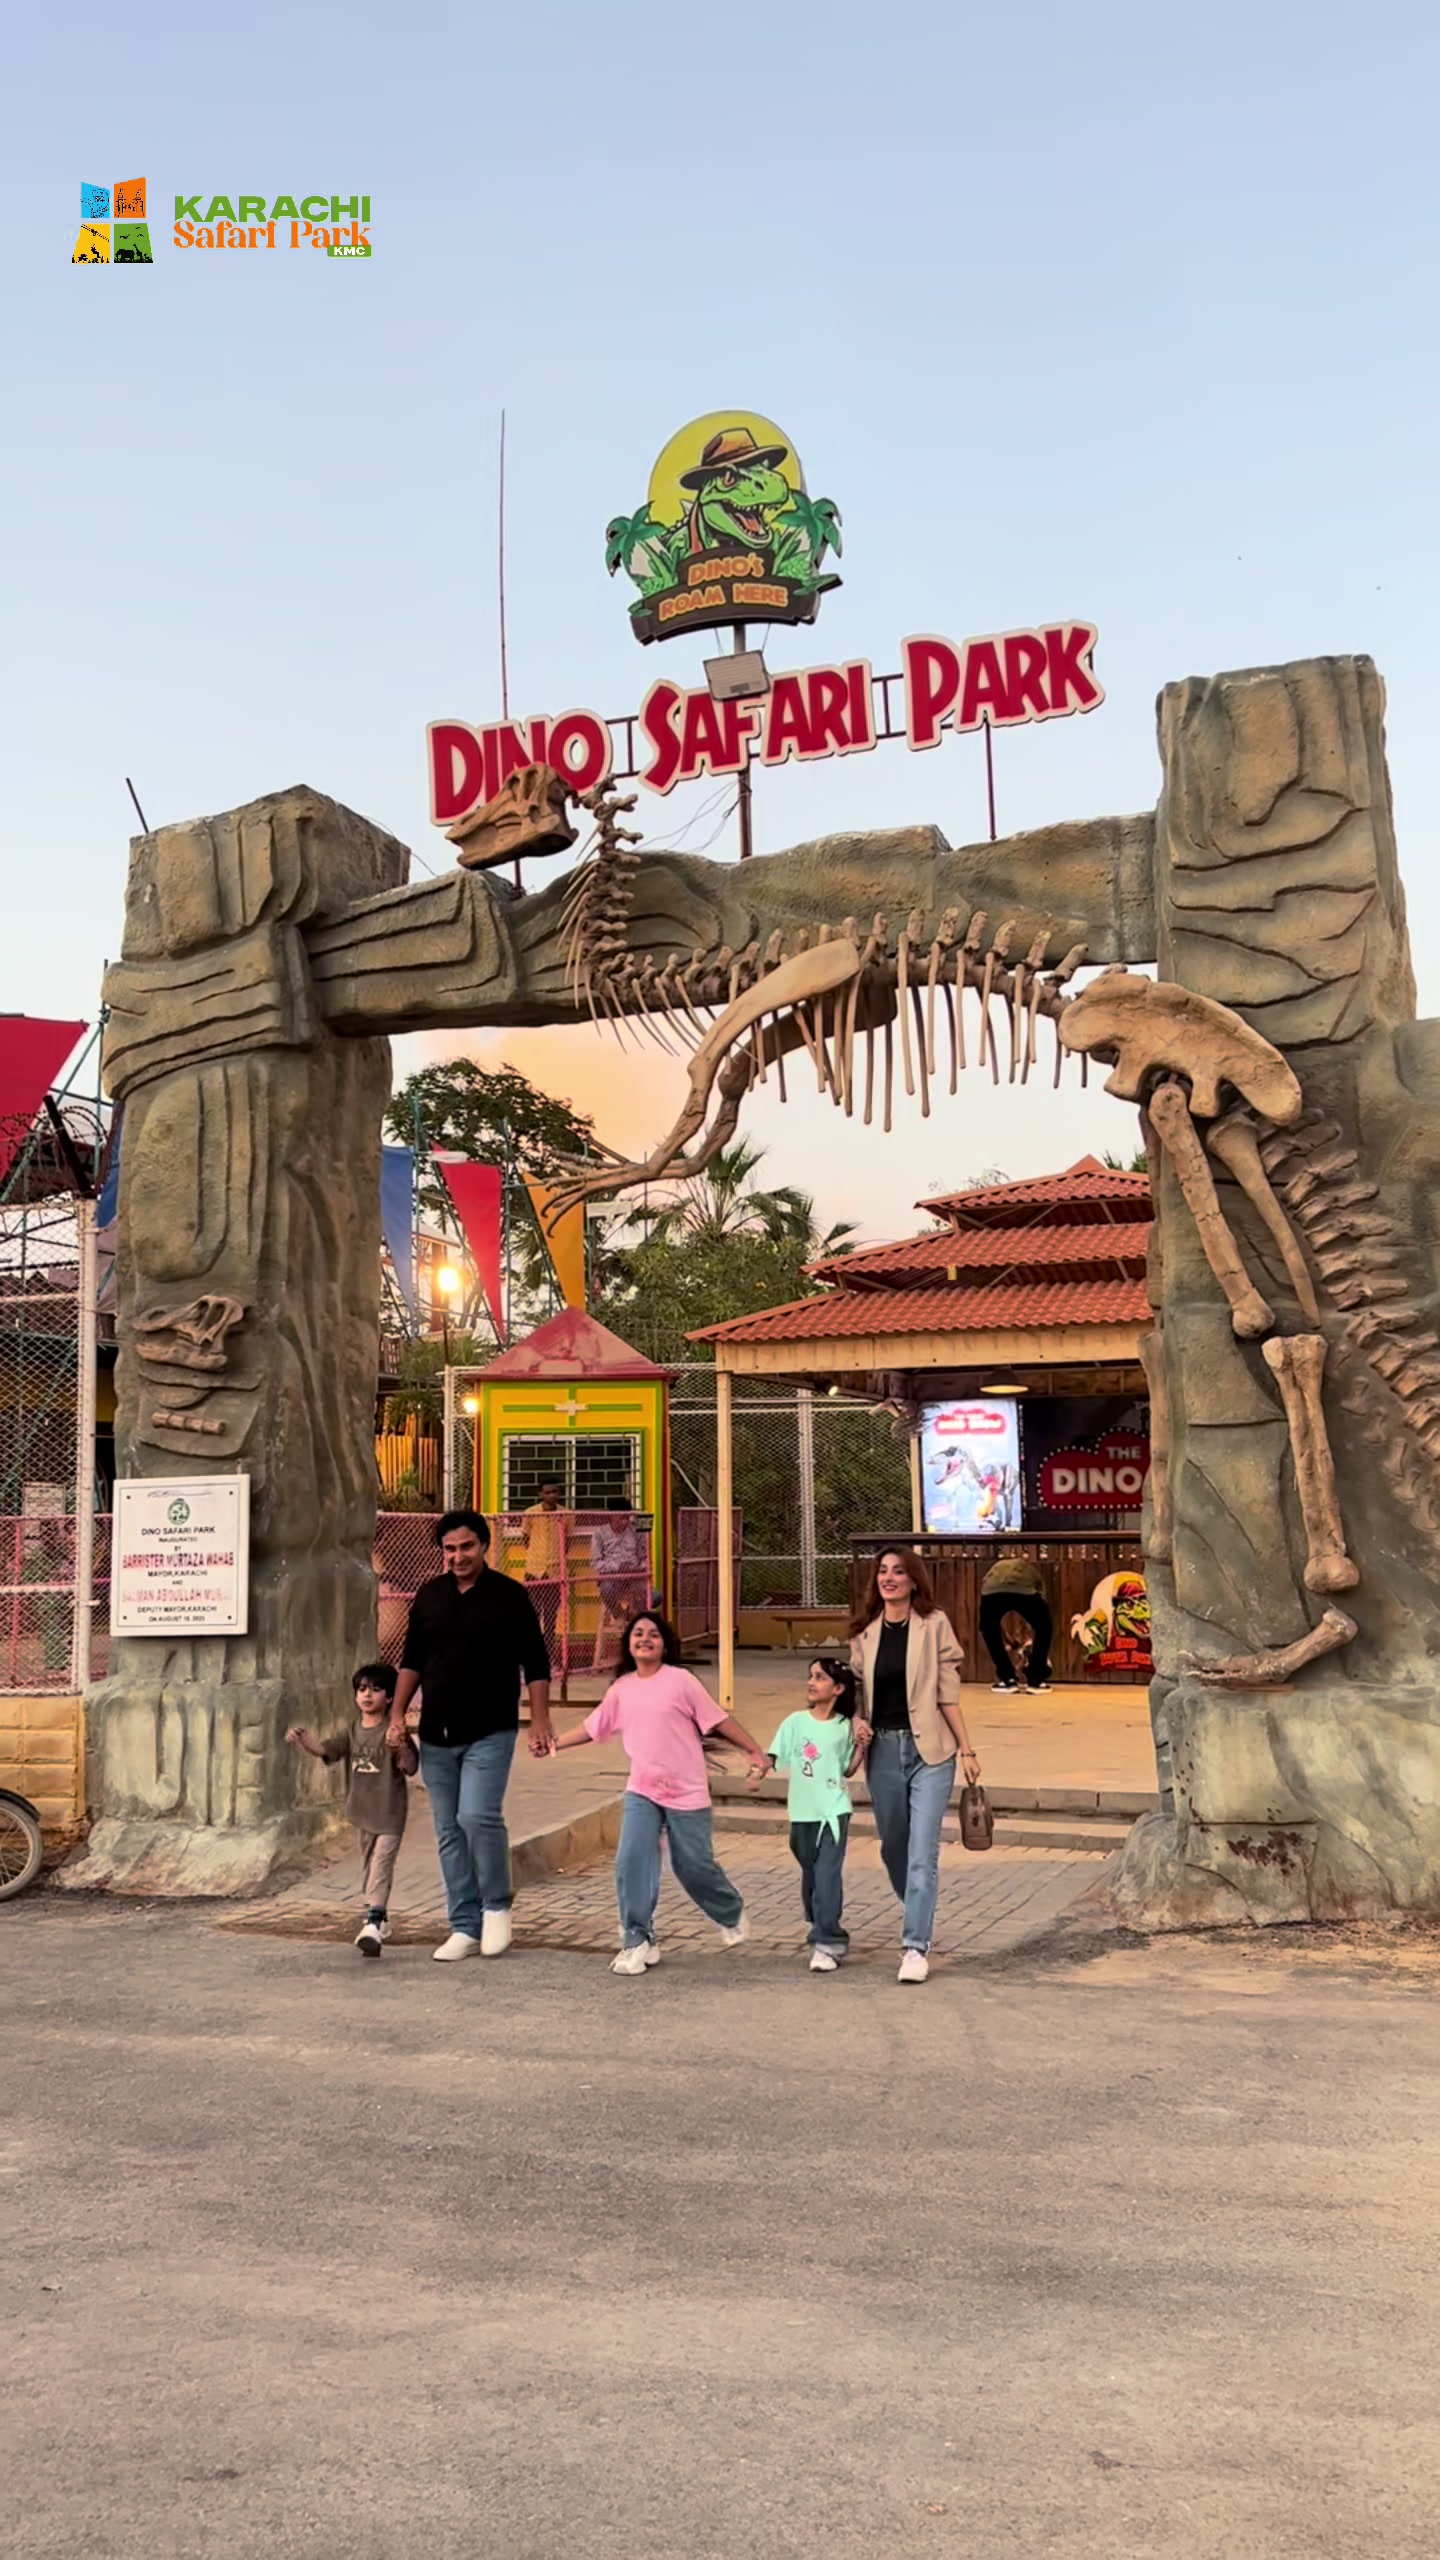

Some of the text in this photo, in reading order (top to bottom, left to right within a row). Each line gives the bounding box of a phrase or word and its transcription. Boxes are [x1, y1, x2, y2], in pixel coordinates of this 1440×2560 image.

[659, 583, 788, 622] ROAM HERE
[429, 623, 1102, 822] DINO SAFARI PARK
[1106, 1446, 1142, 1460] THE
[1052, 1466, 1143, 1494] DINO
[141, 1526, 216, 1536] DINO SAFARI PARK
[166, 1552, 204, 1568] MURTAZA
